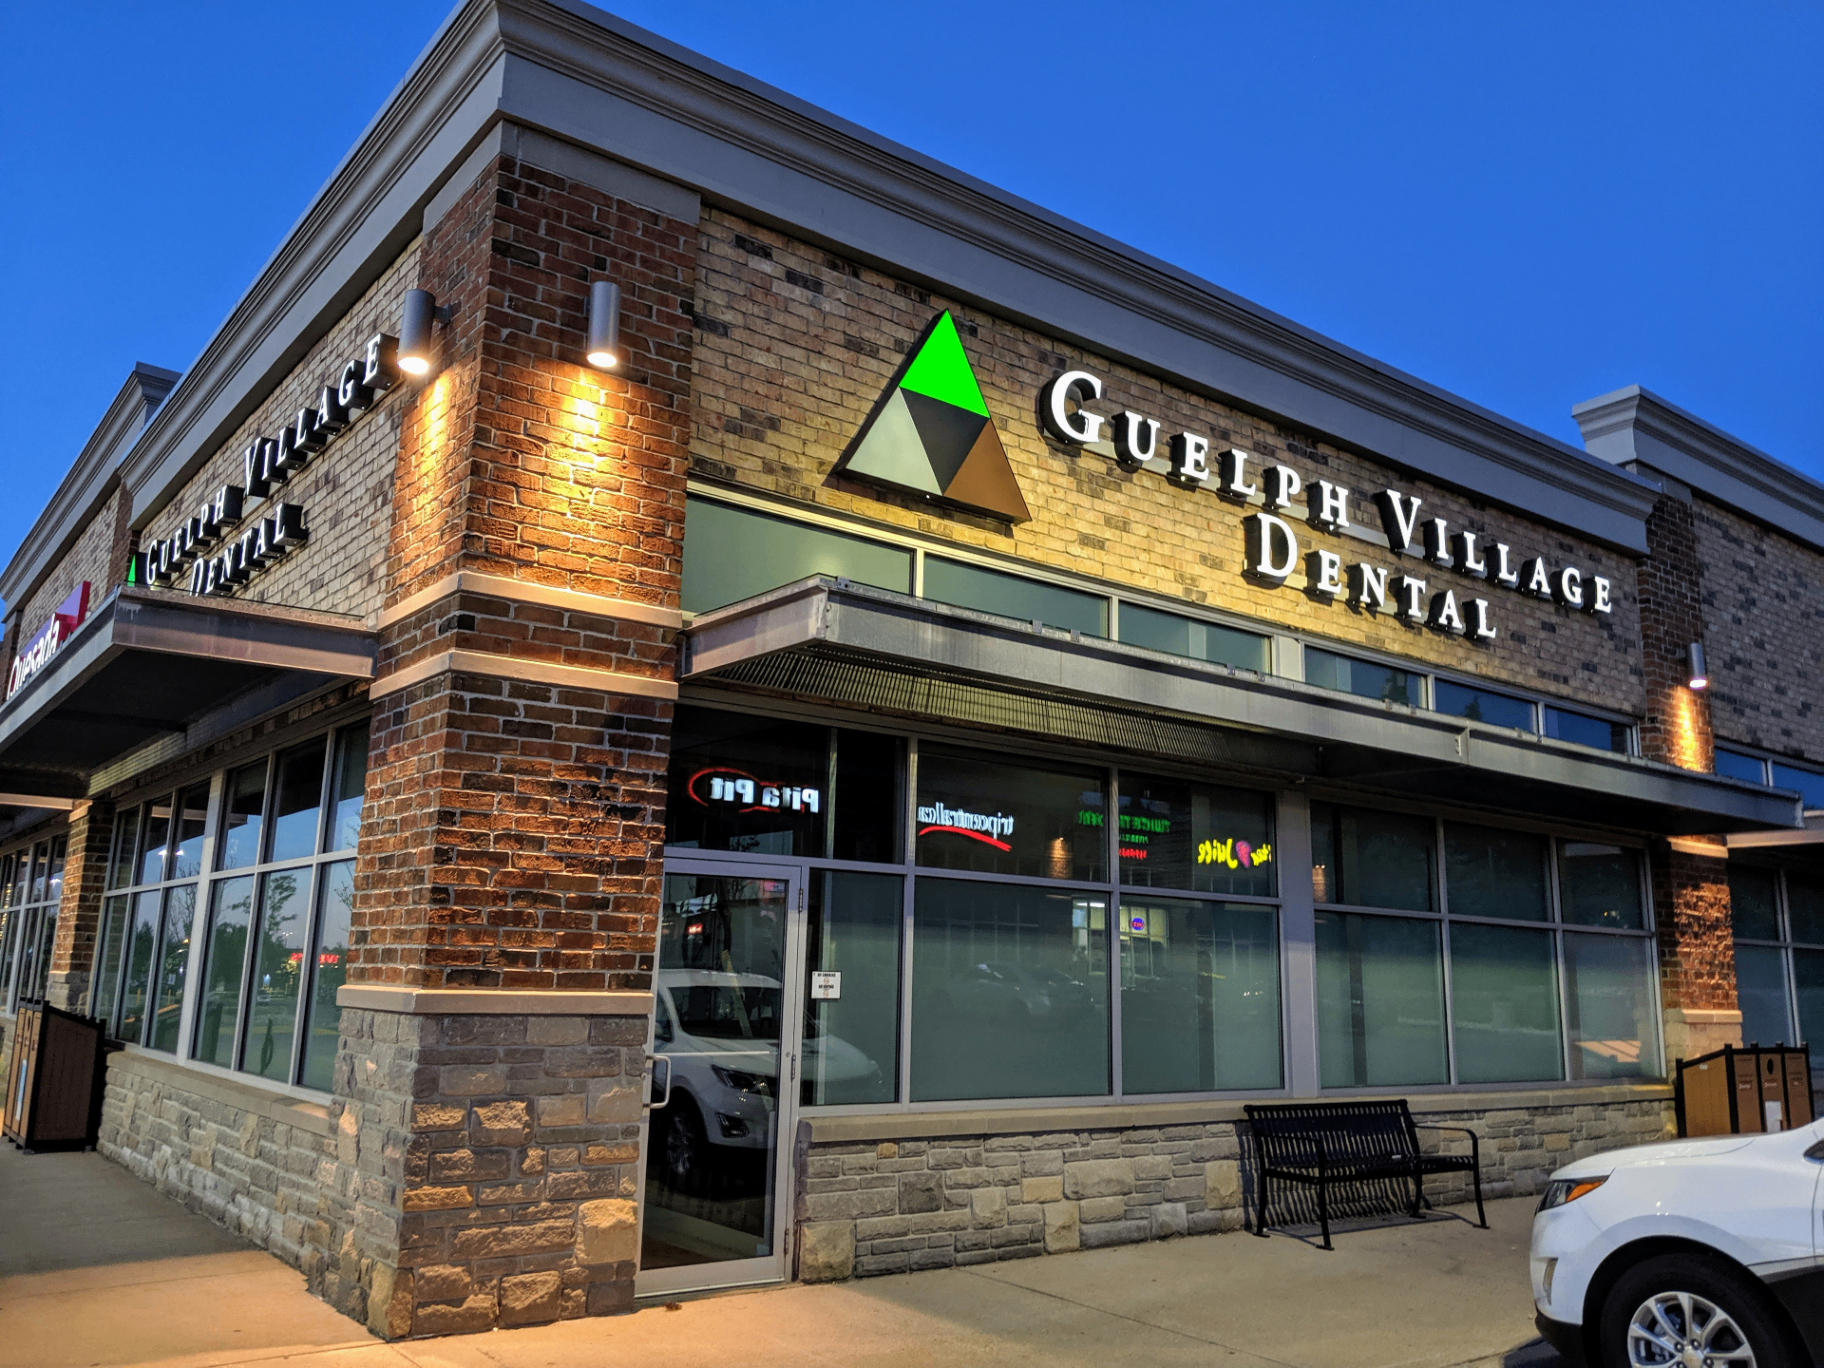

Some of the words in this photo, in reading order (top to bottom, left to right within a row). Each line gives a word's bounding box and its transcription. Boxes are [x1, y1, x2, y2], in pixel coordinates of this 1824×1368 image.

[146, 484, 229, 585] GUELPH
[243, 334, 381, 496] VILLAGE
[189, 502, 285, 597] DENTAL
[1049, 369, 1351, 529] GUELPH
[1385, 488, 1613, 614] VILLAGE
[1256, 511, 1498, 639] DENTAL
